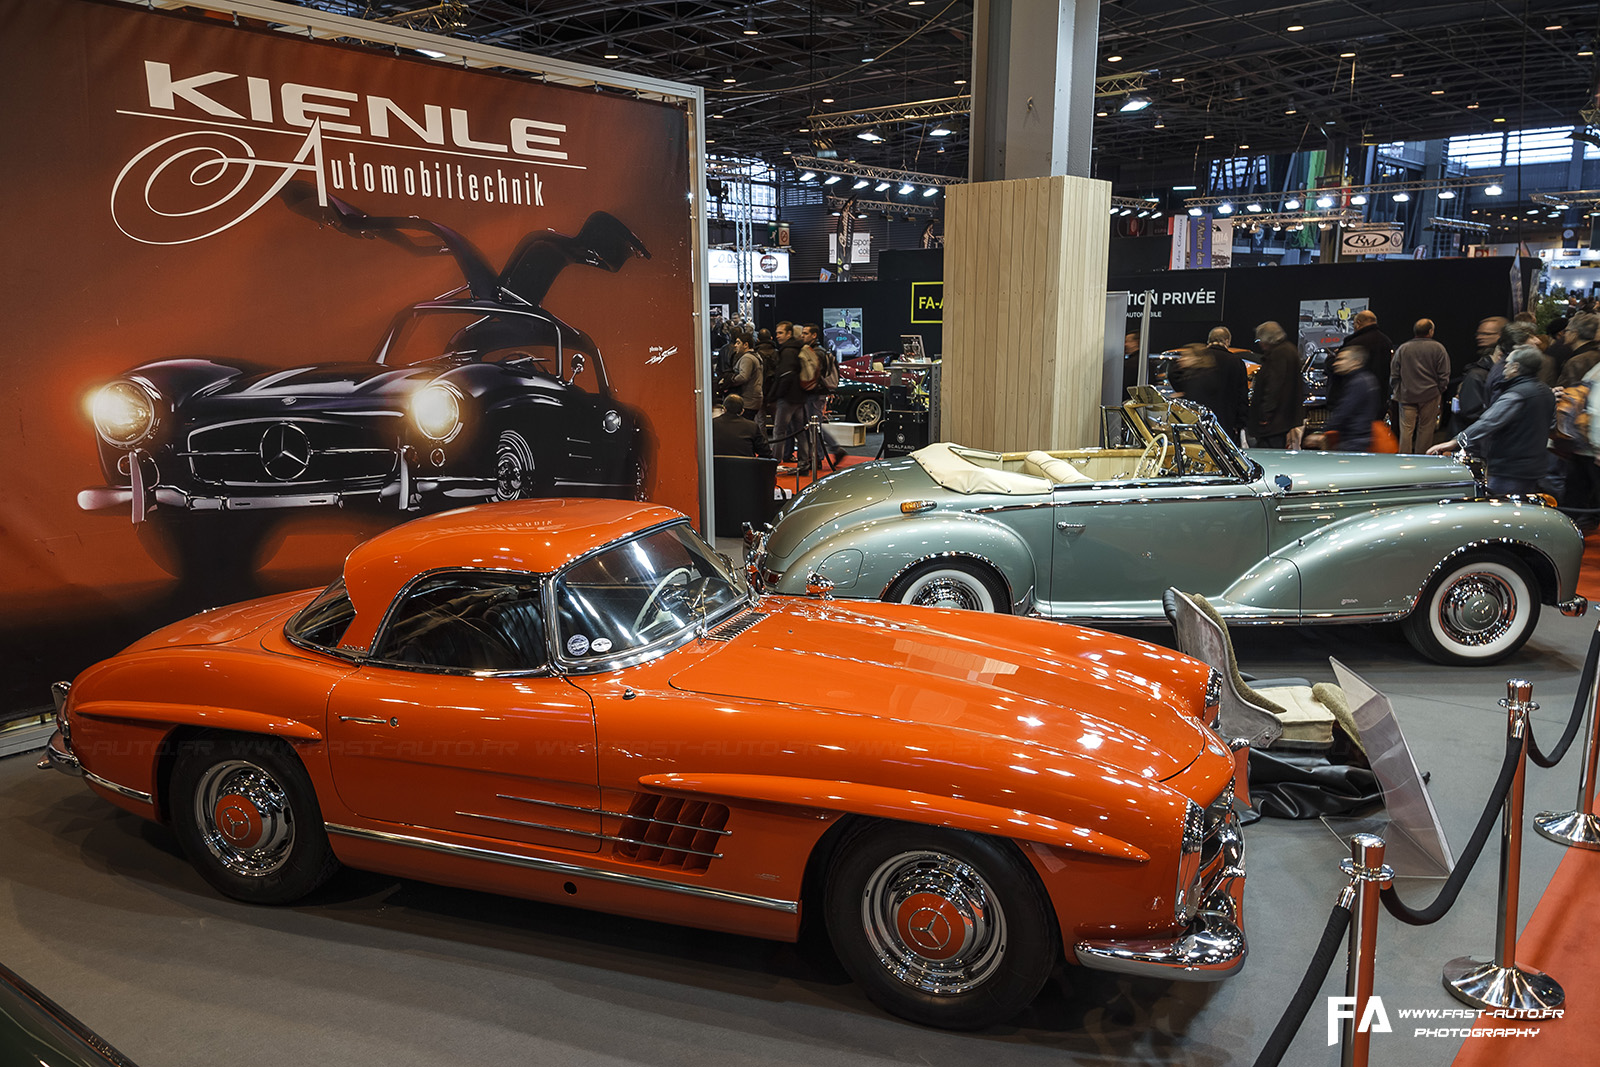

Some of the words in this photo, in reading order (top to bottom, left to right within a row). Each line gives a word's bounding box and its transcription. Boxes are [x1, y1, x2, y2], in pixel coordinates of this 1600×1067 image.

[144, 60, 568, 160] KIENLE
[111, 116, 545, 245] Automobiltechnik
[1162, 288, 1216, 305] PRIVÉE
